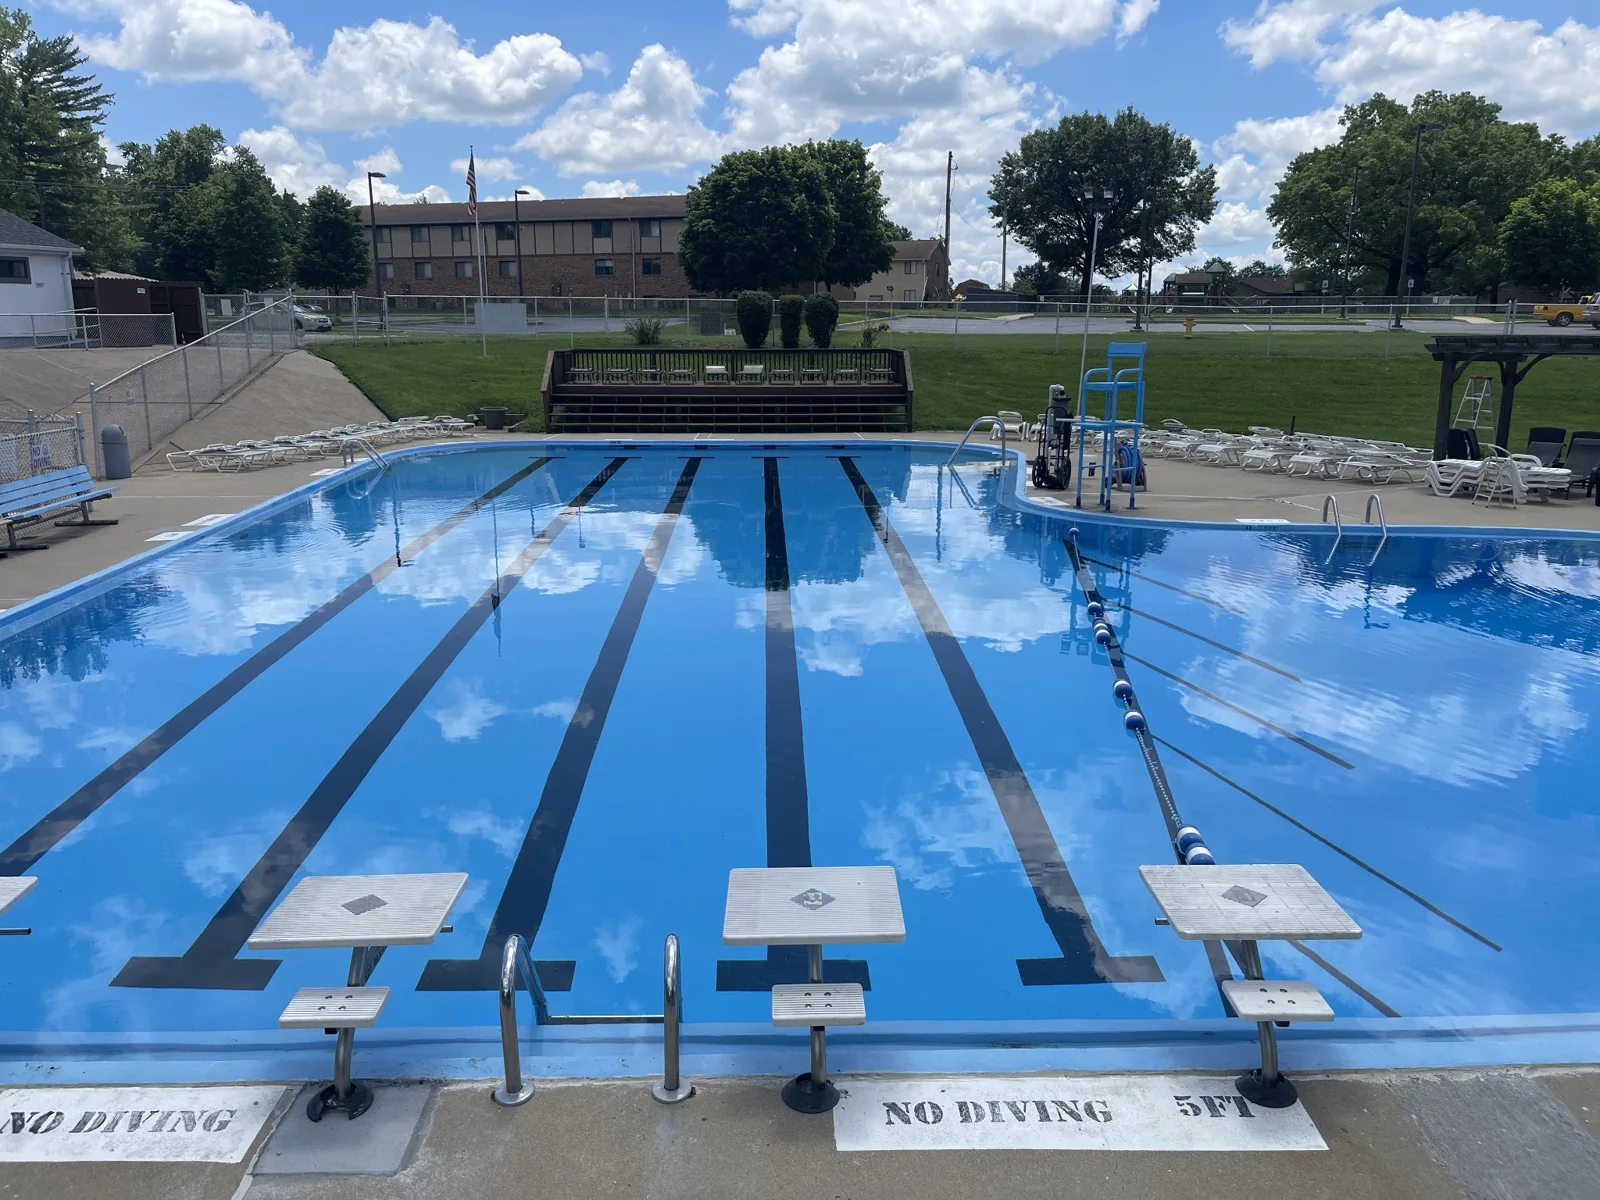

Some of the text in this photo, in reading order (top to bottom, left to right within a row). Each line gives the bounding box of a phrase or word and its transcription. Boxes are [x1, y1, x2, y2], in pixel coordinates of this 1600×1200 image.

[32, 446, 41, 456] NO
[33, 456, 51, 468] DIVING
[882, 1095, 1256, 1125] NO DIVING 5FT
[0, 1109, 238, 1134] NO DIVING
